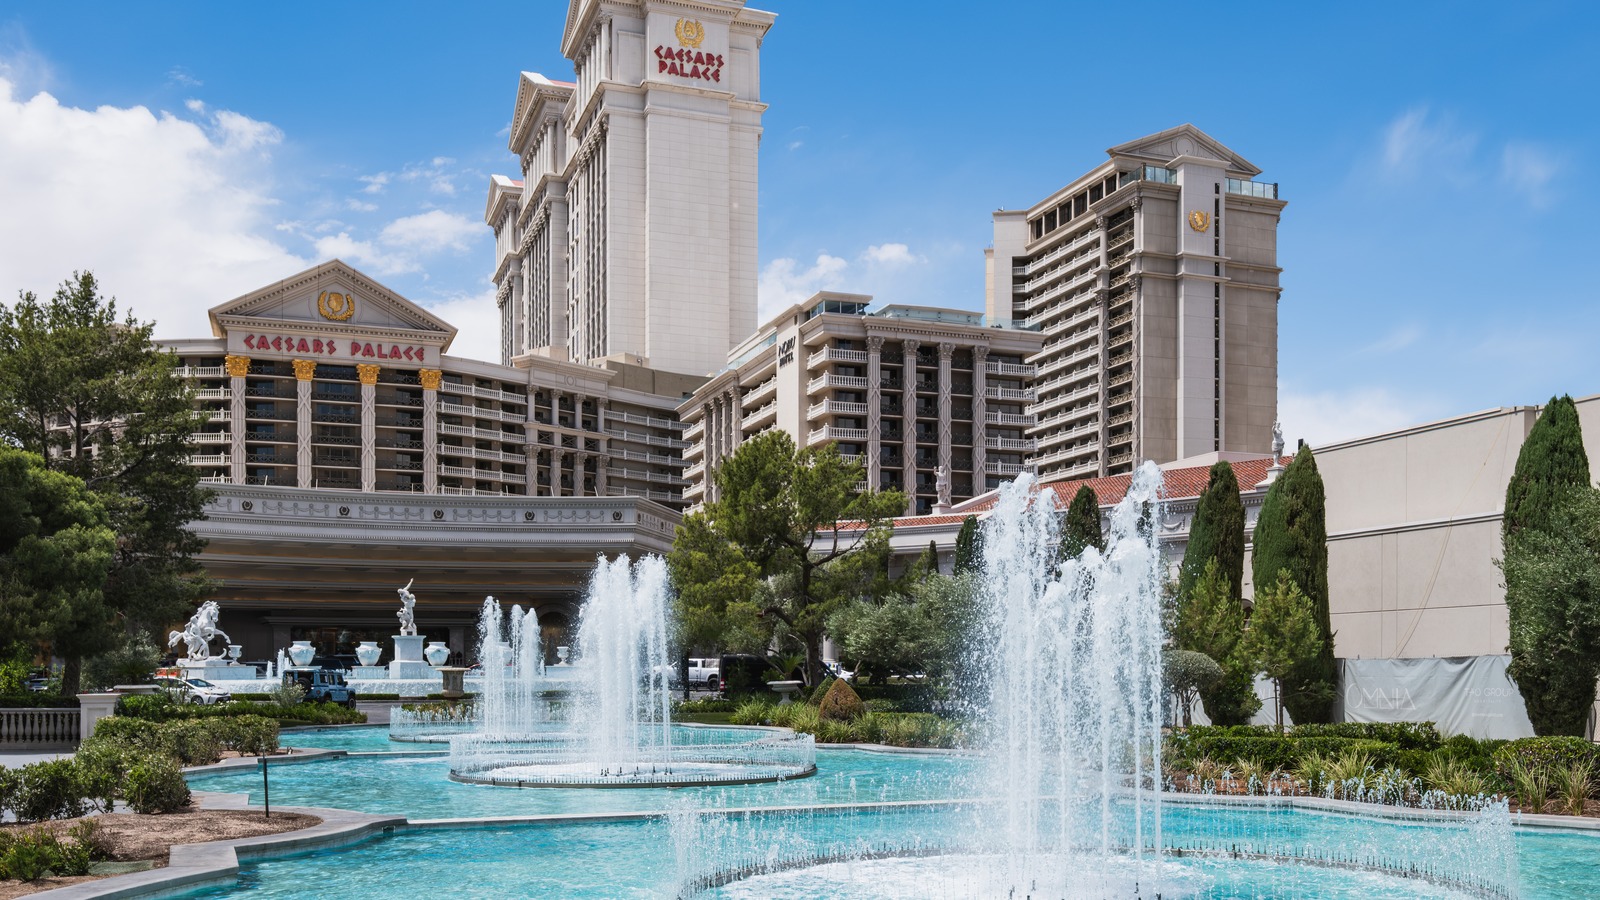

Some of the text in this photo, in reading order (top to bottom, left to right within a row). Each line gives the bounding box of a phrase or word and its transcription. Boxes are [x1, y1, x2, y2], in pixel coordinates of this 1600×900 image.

[654, 45, 724, 68] CAESARS
[659, 60, 720, 82] PALACE
[243, 333, 425, 362] CAESARS PALACE
[1345, 682, 1417, 711] OMNIA
